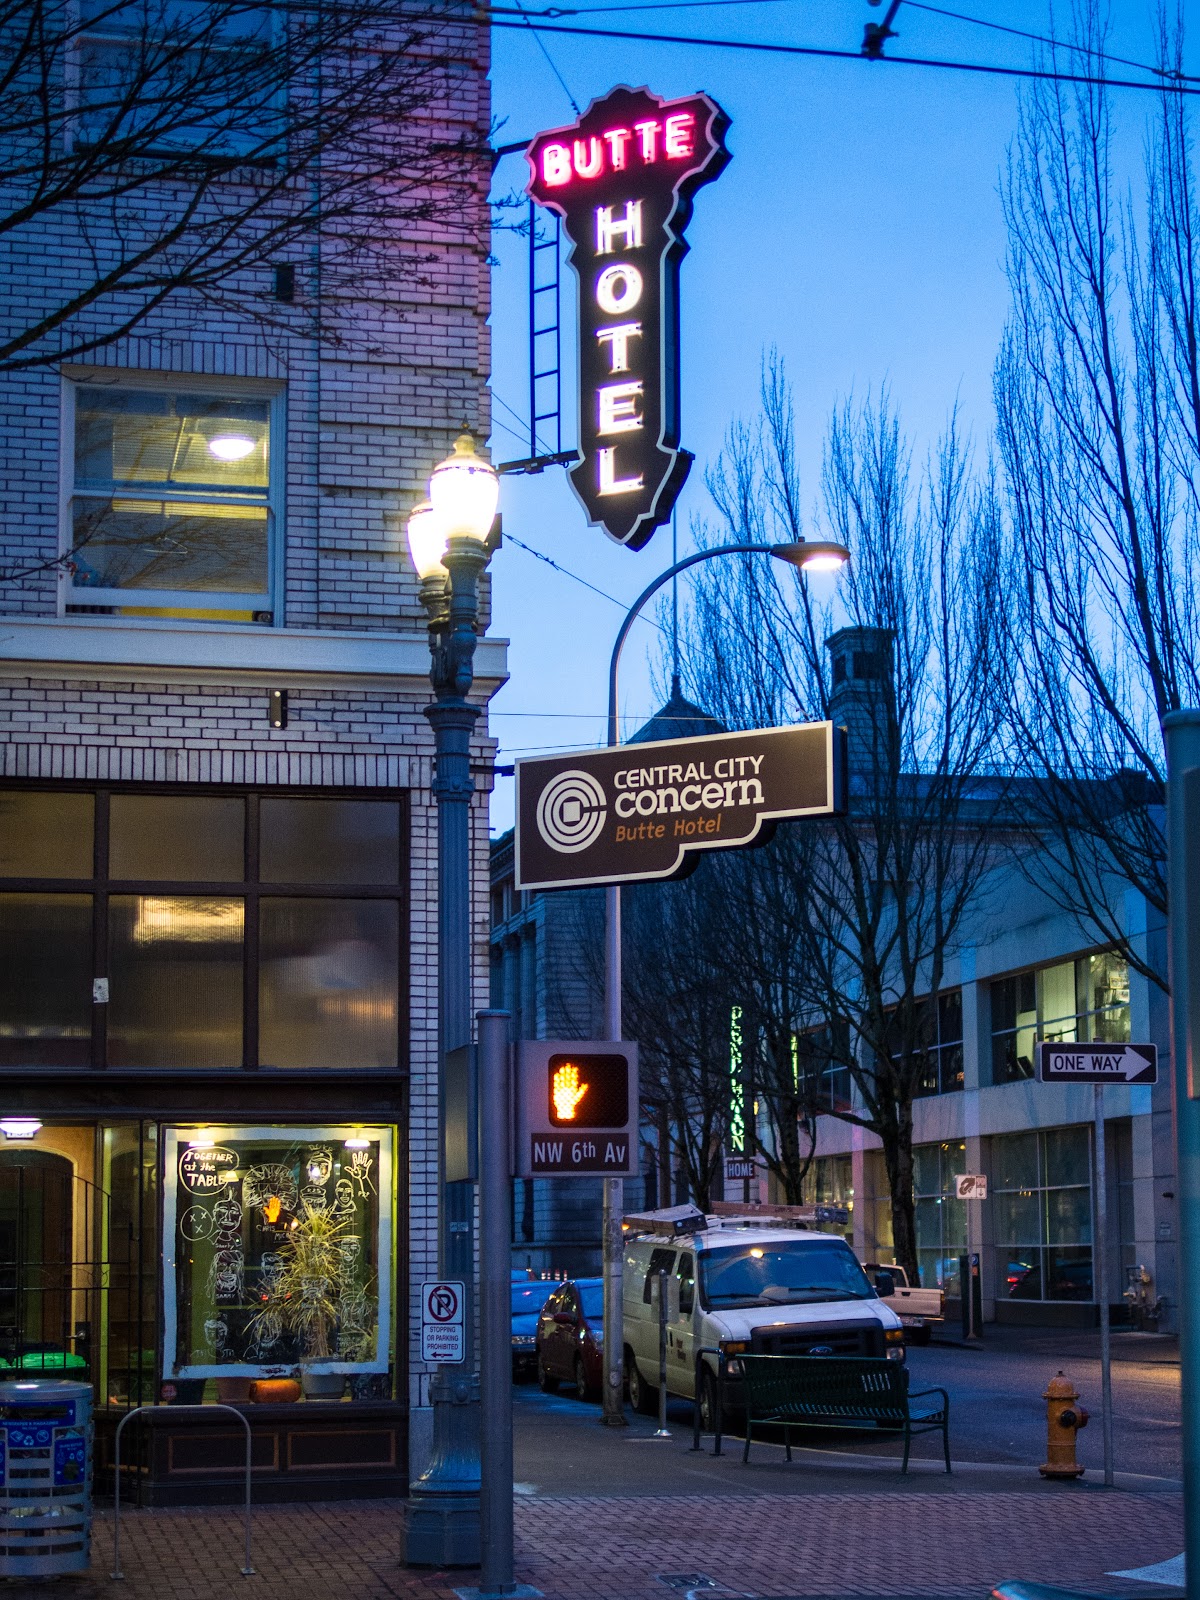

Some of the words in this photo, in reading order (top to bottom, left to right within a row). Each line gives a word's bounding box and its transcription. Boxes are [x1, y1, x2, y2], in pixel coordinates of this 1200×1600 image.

[541, 113, 694, 187] BUTTE
[595, 200, 645, 497] HOTEL
[614, 762, 711, 789] CENTRAL
[714, 755, 765, 779] CITY
[614, 777, 765, 818] concern
[616, 822, 665, 842] Butte
[674, 814, 721, 837] Hotel
[1054, 1055, 1085, 1071] ONE
[1091, 1055, 1123, 1071] WAY
[534, 1142, 563, 1163] NW
[571, 1142, 596, 1163] 6th
[604, 1142, 626, 1163] Av
[186, 1173, 225, 1187] TABLE
[728, 1162, 754, 1178] HOME
[427, 1334, 435, 1342] OR
[436, 1334, 459, 1342] PARKING
